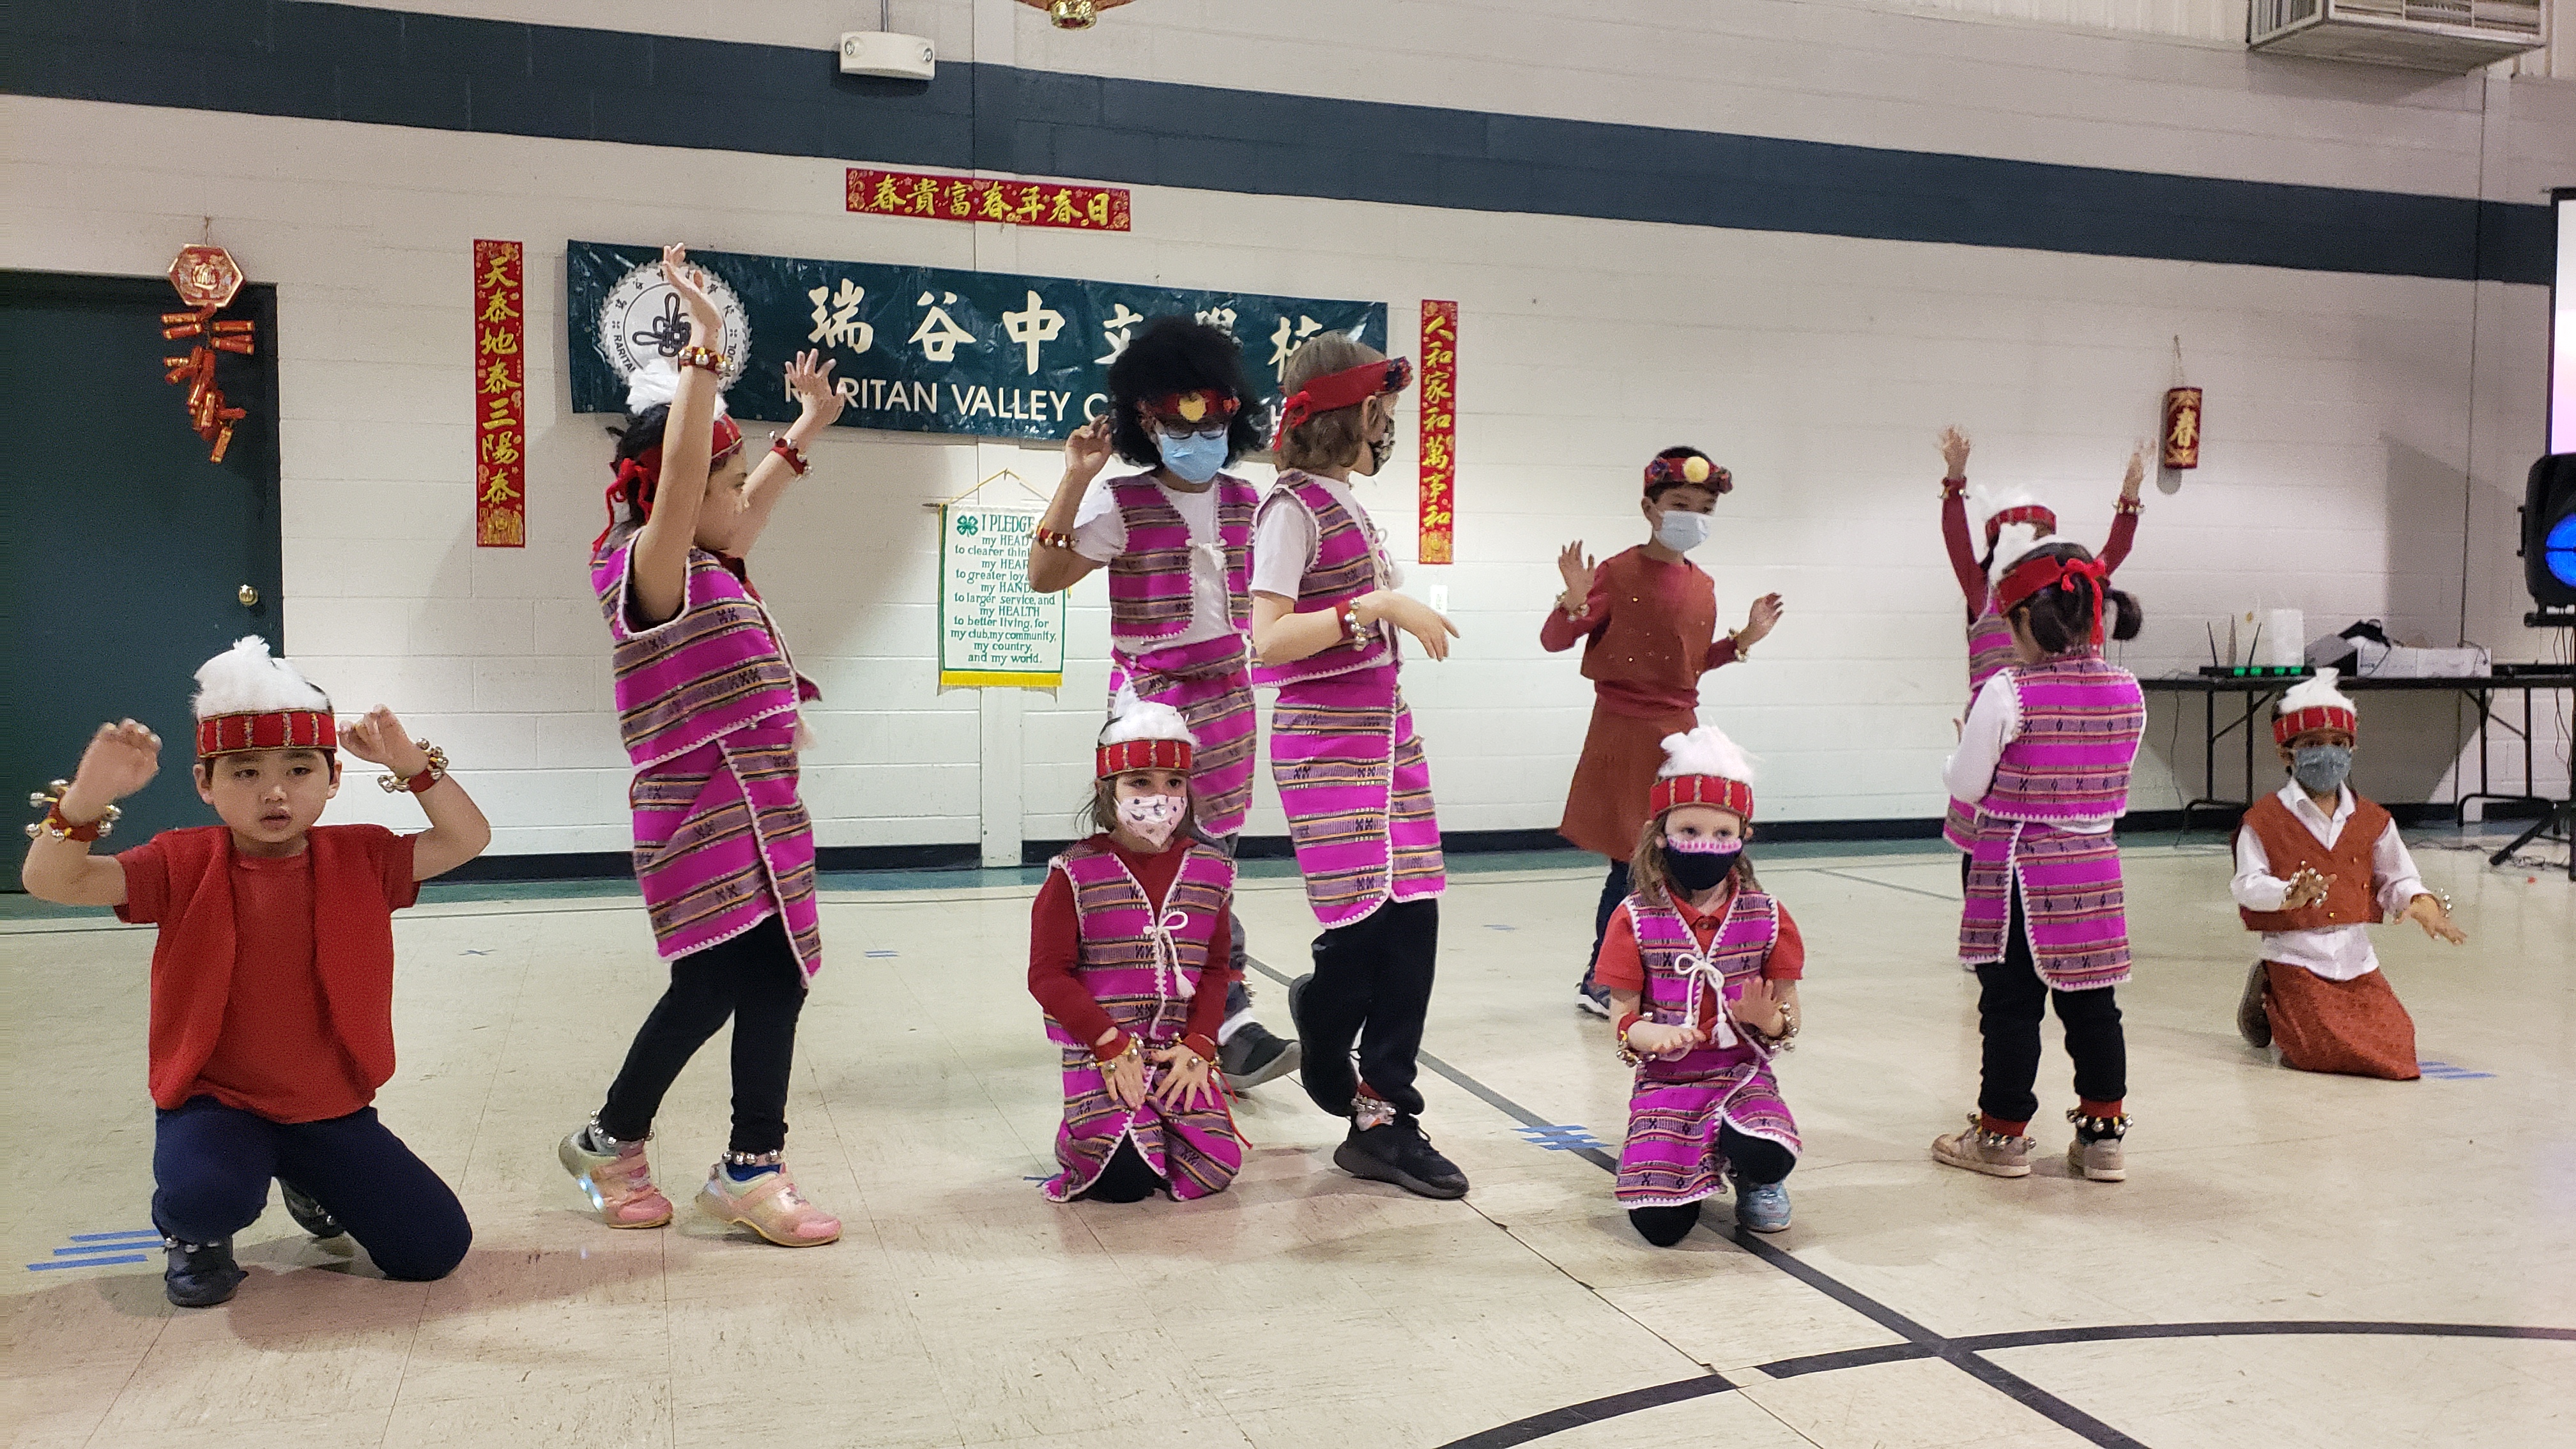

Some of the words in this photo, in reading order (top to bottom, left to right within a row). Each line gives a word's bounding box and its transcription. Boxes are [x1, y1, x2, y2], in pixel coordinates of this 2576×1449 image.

[785, 373, 937, 413] RRITAN
[951, 384, 1071, 422] VALLEY
[982, 514, 986, 531] I
[982, 536, 997, 548] my
[955, 544, 965, 554] to
[968, 545, 1004, 556] clearer
[981, 560, 997, 571] my
[956, 569, 965, 578] to
[967, 570, 1007, 584] greater
[981, 584, 995, 595] my
[1000, 582, 1036, 594] HAND
[954, 592, 964, 602] to
[967, 592, 996, 607] larger
[1000, 595, 1036, 606] service,
[1038, 595, 1055, 605] and
[979, 608, 995, 618] my
[999, 606, 1040, 617] HEALTH
[954, 615, 964, 625] to
[967, 615, 997, 626] better
[1034, 618, 1049, 628] for
[951, 629, 967, 641] my
[1005, 630, 1056, 643] community,
[974, 642, 989, 653] my
[992, 642, 1032, 654] country,
[968, 652, 987, 662] and
[991, 655, 1008, 666] my
[1011, 653, 1042, 663] world.
